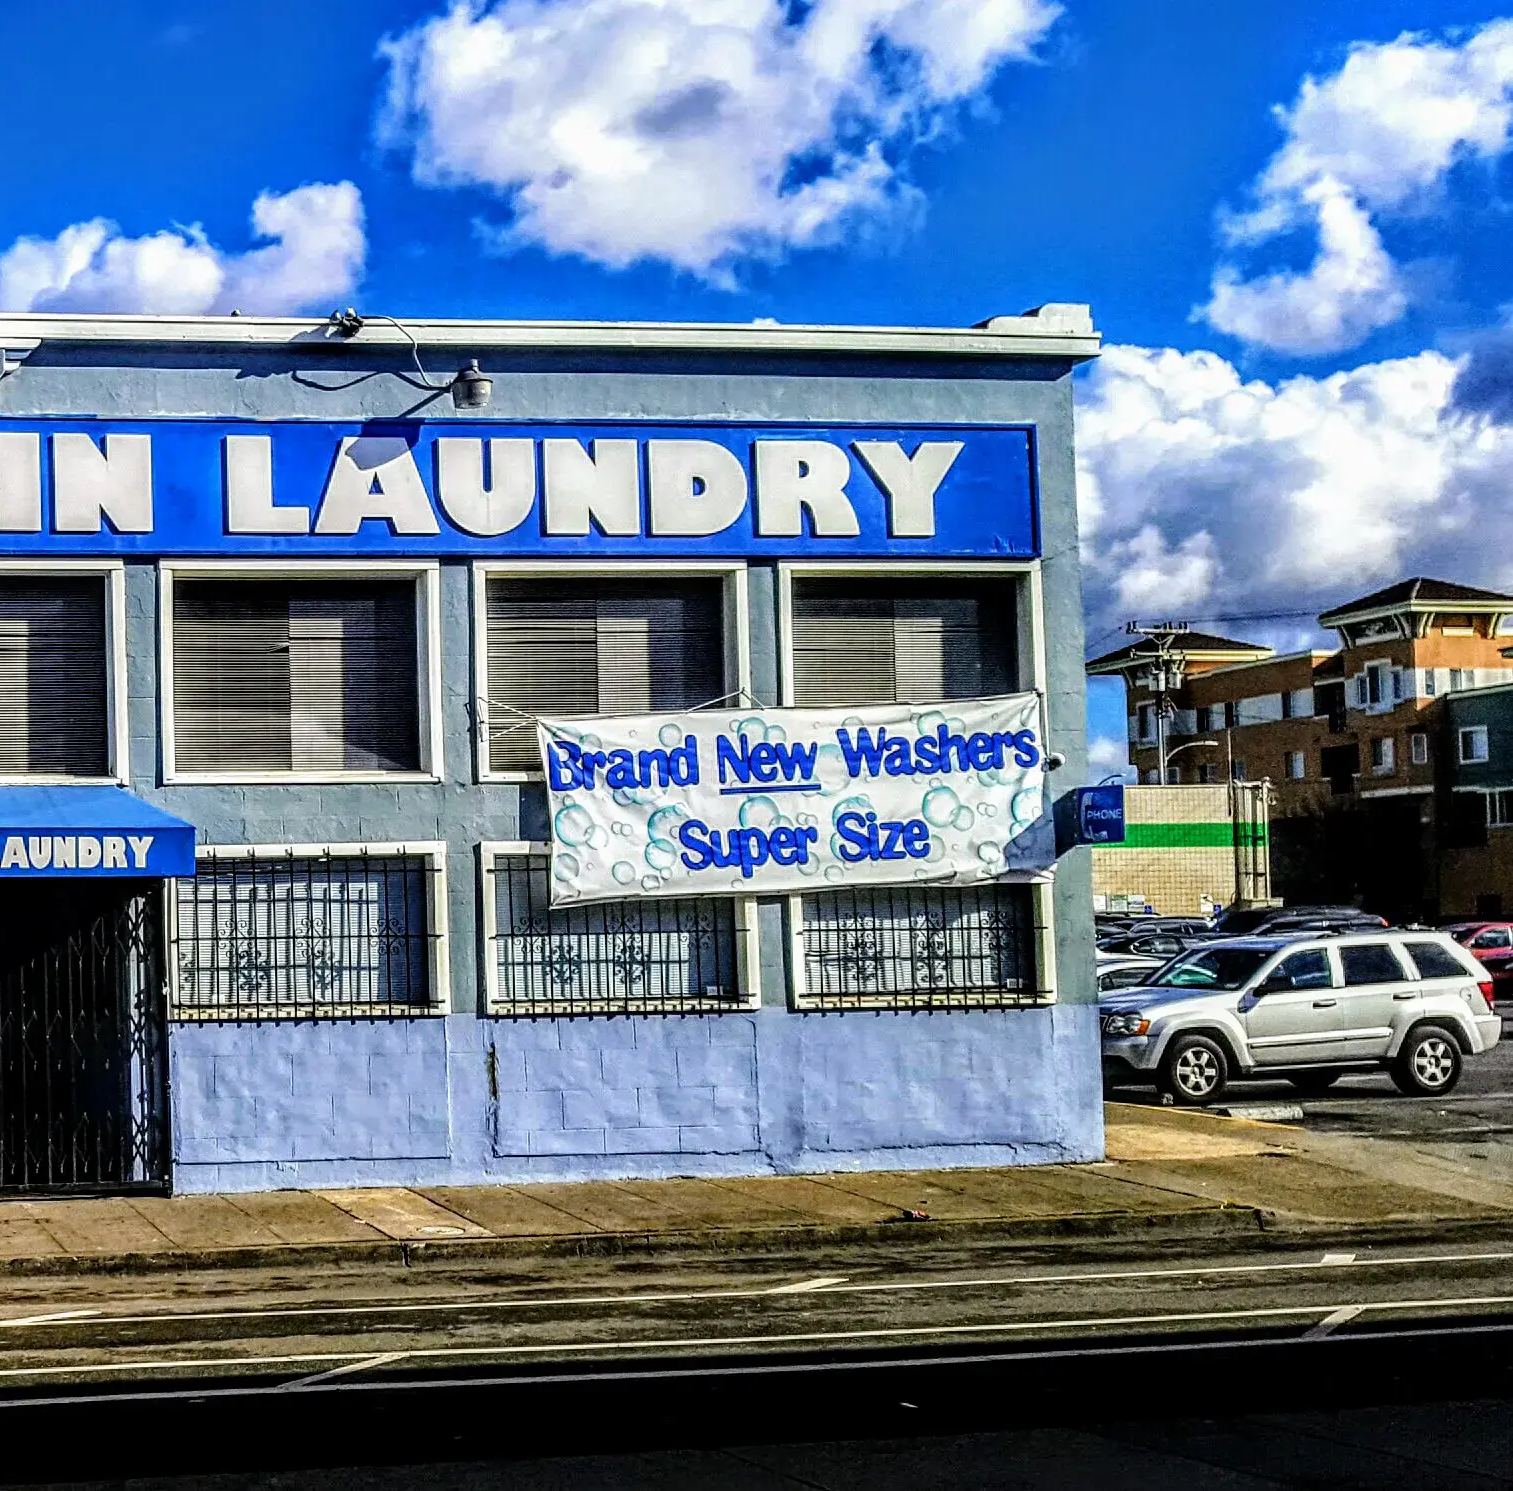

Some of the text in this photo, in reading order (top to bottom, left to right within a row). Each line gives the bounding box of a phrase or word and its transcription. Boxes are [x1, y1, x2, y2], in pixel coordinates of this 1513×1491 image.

[225, 434, 966, 537] LAUNDRY
[547, 724, 1041, 792] Brand New Washers
[679, 810, 932, 879] Super Size
[1086, 808, 1123, 820] PHONE
